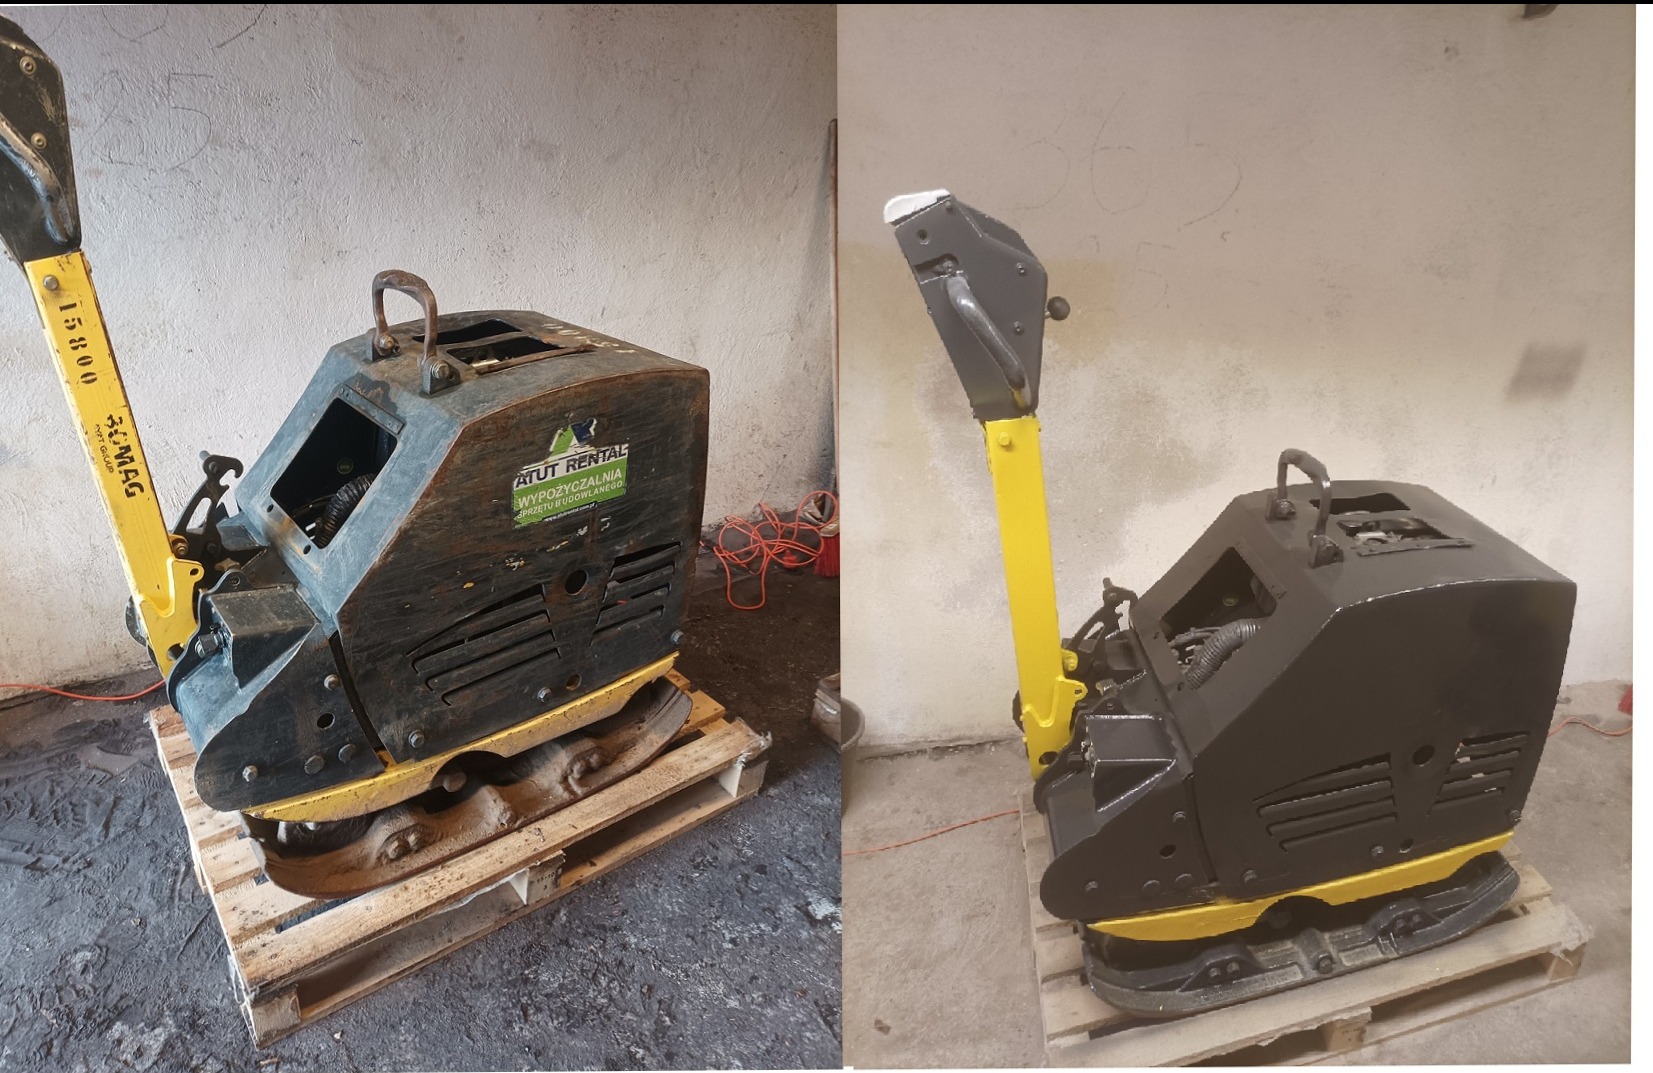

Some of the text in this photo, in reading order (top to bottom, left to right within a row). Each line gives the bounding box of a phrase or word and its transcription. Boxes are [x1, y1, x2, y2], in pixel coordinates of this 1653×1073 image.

[58, 302, 98, 385] 15800
[515, 443, 629, 488] ATUT RENTAL
[518, 468, 622, 509] WYPOŻYCZALNIA
[555, 480, 623, 508] BUDOWLANEGO
